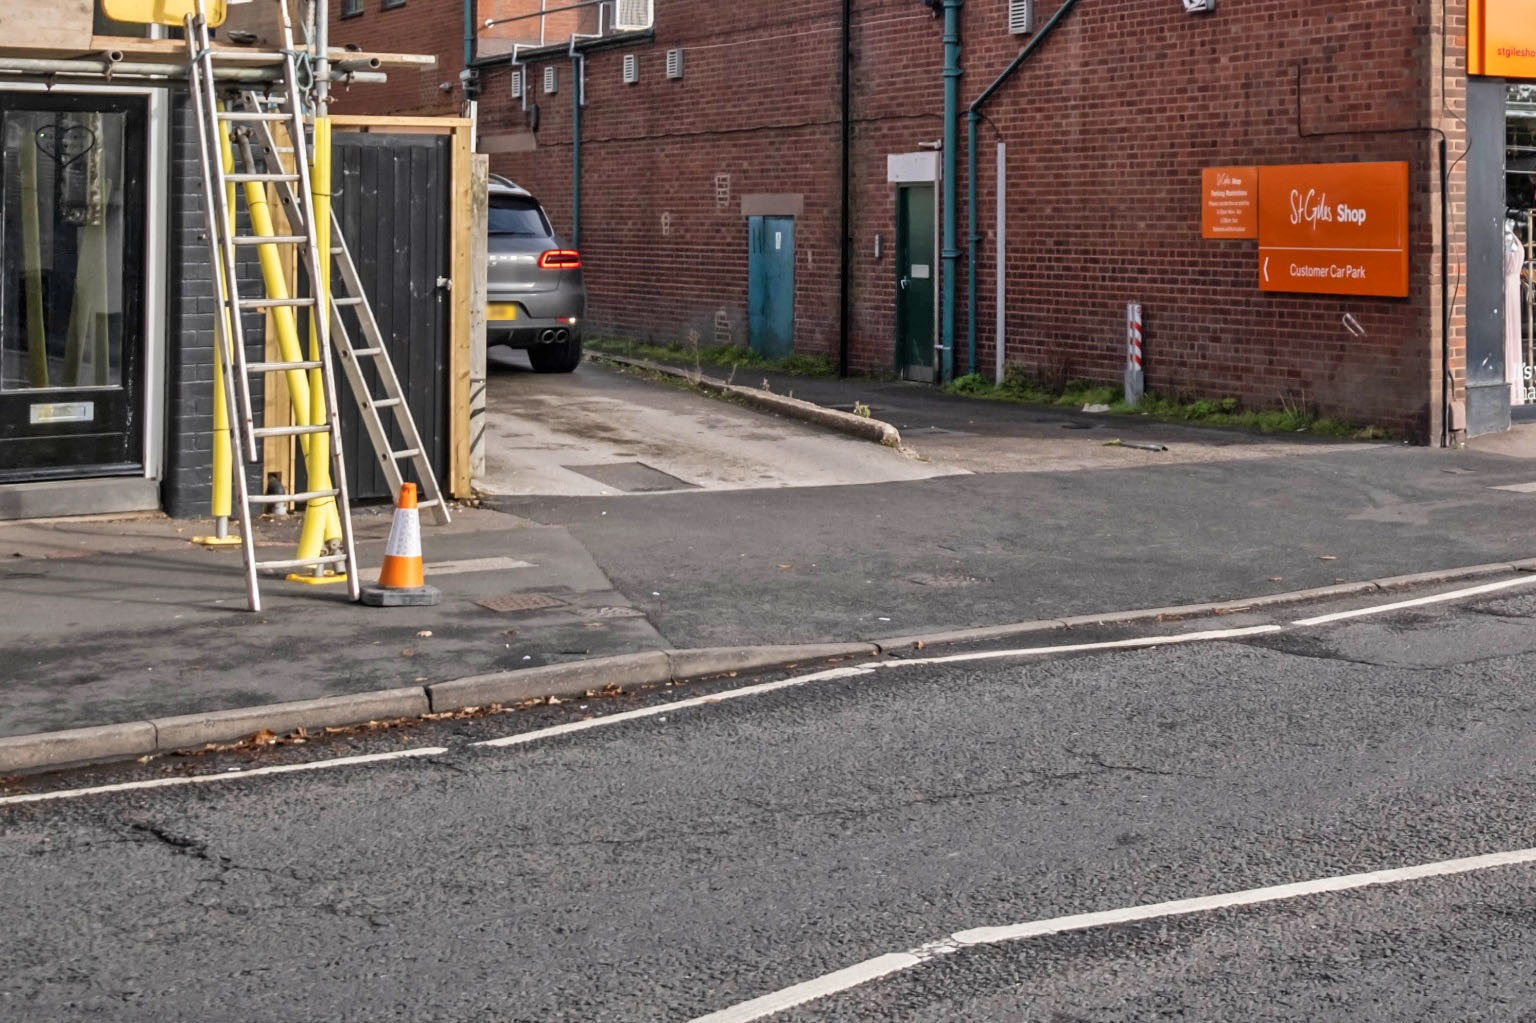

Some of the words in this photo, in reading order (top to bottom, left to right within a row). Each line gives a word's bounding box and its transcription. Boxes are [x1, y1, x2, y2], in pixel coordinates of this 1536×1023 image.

[1290, 189, 1303, 225] St
[1304, 188, 1332, 231] Giles
[1337, 203, 1366, 226] Shop
[1290, 263, 1328, 277] Customer
[1330, 264, 1345, 278] Car
[1346, 265, 1366, 279] Park
